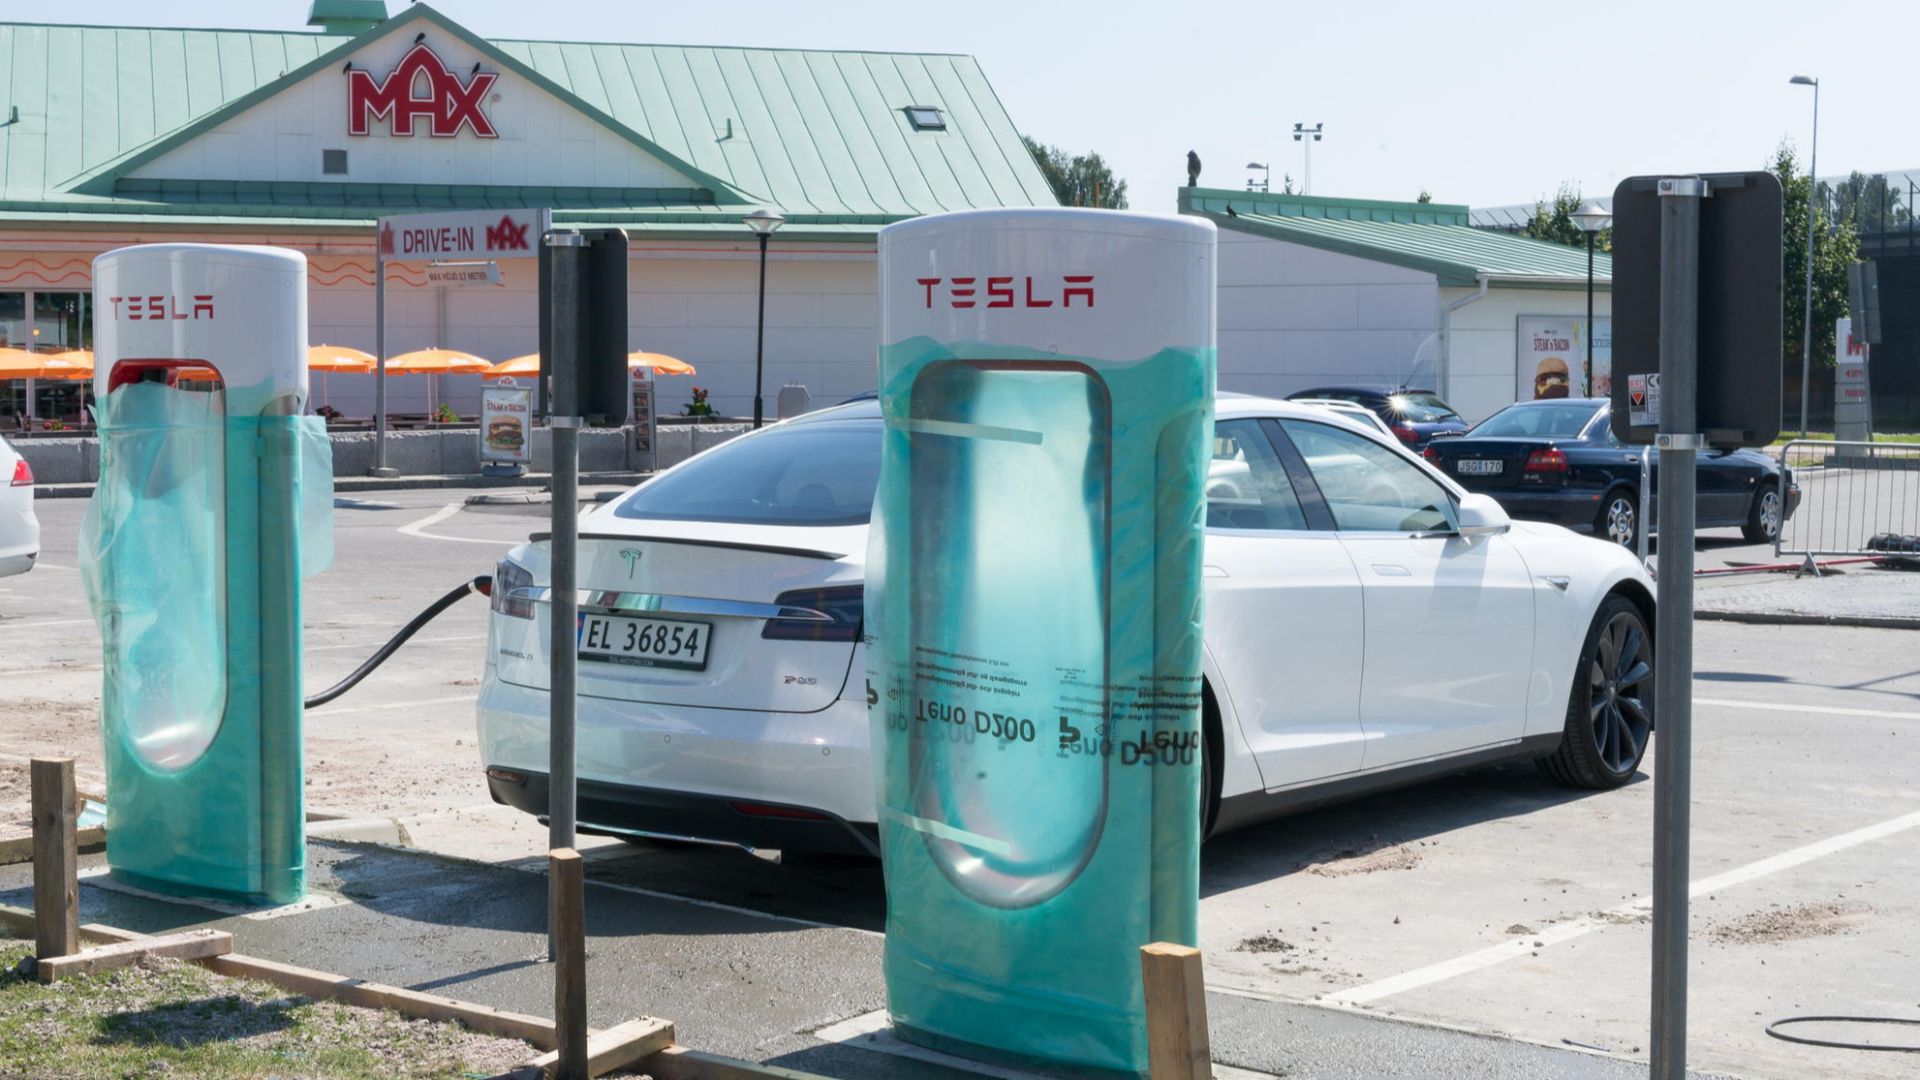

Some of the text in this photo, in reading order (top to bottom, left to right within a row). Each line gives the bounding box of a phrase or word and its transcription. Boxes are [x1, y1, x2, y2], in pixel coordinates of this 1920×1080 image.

[349, 44, 499, 138] MAX
[403, 214, 529, 253] DRIVE-IN MAX
[110, 295, 214, 320] TESLA
[917, 275, 1095, 309] TESLA
[1459, 461, 1501, 472] JSG 170
[587, 620, 700, 657] EL 36854
